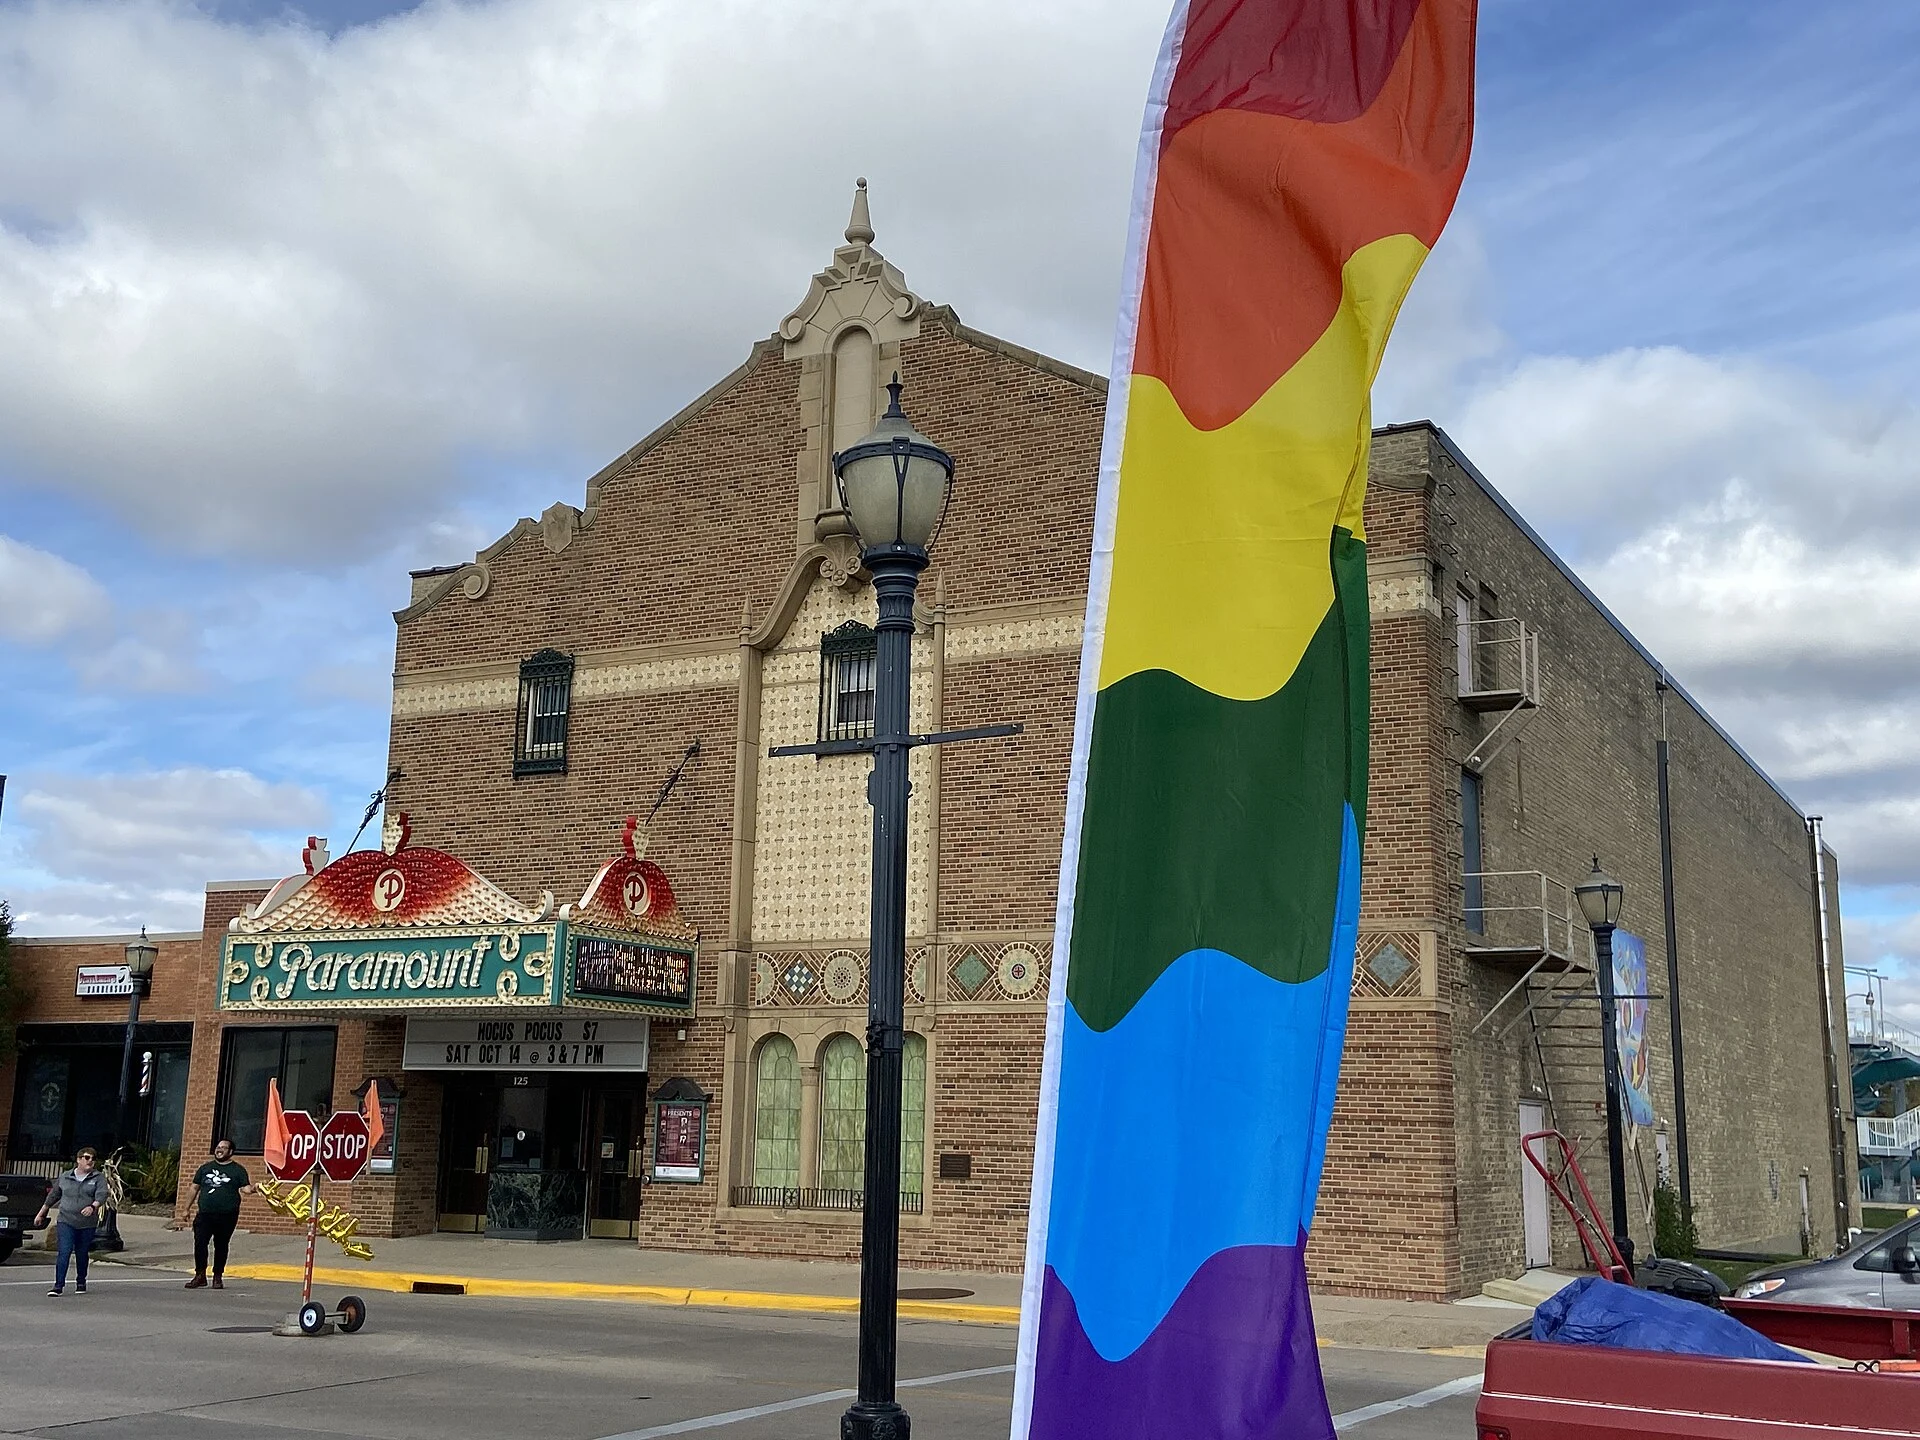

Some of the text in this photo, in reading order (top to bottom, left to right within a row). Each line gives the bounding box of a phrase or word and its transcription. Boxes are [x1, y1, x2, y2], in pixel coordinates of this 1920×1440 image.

[275, 936, 492, 1000] Paramount
[477, 1022, 514, 1041] HOCUS
[524, 1022, 563, 1041] POCUS
[446, 1044, 604, 1063] SAT OCT 14 @ 3 & 7 PM
[513, 1076, 529, 1086] 125
[322, 1134, 367, 1159] STOP
